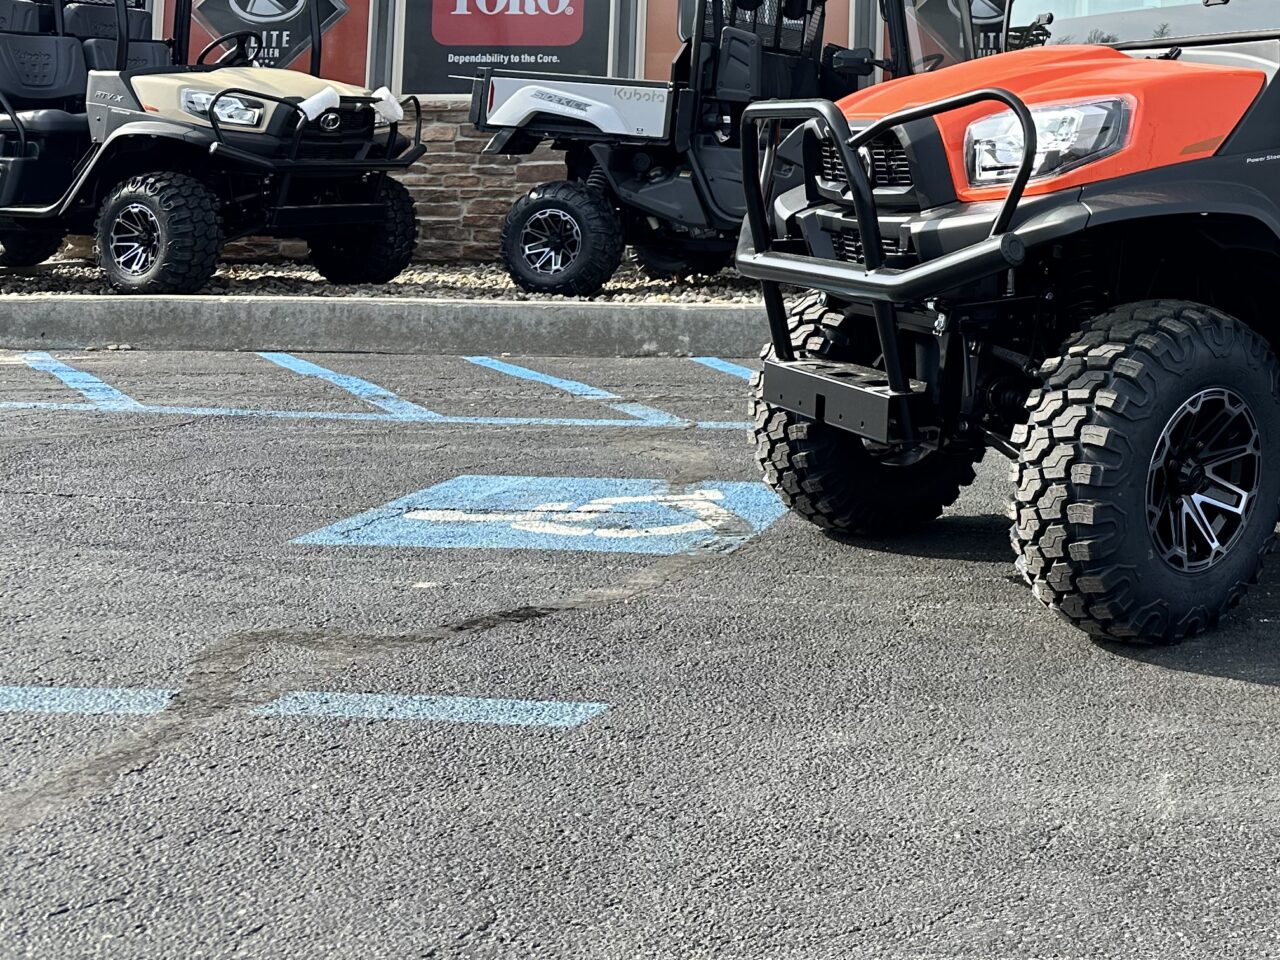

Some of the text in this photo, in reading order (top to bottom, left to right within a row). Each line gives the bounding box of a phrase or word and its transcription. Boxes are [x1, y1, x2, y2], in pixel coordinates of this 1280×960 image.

[245, 30, 291, 48] LITE
[448, 53, 560, 65] Dependability to the Core.
[531, 90, 593, 113] SIDEKICK
[613, 87, 666, 103] Kubota
